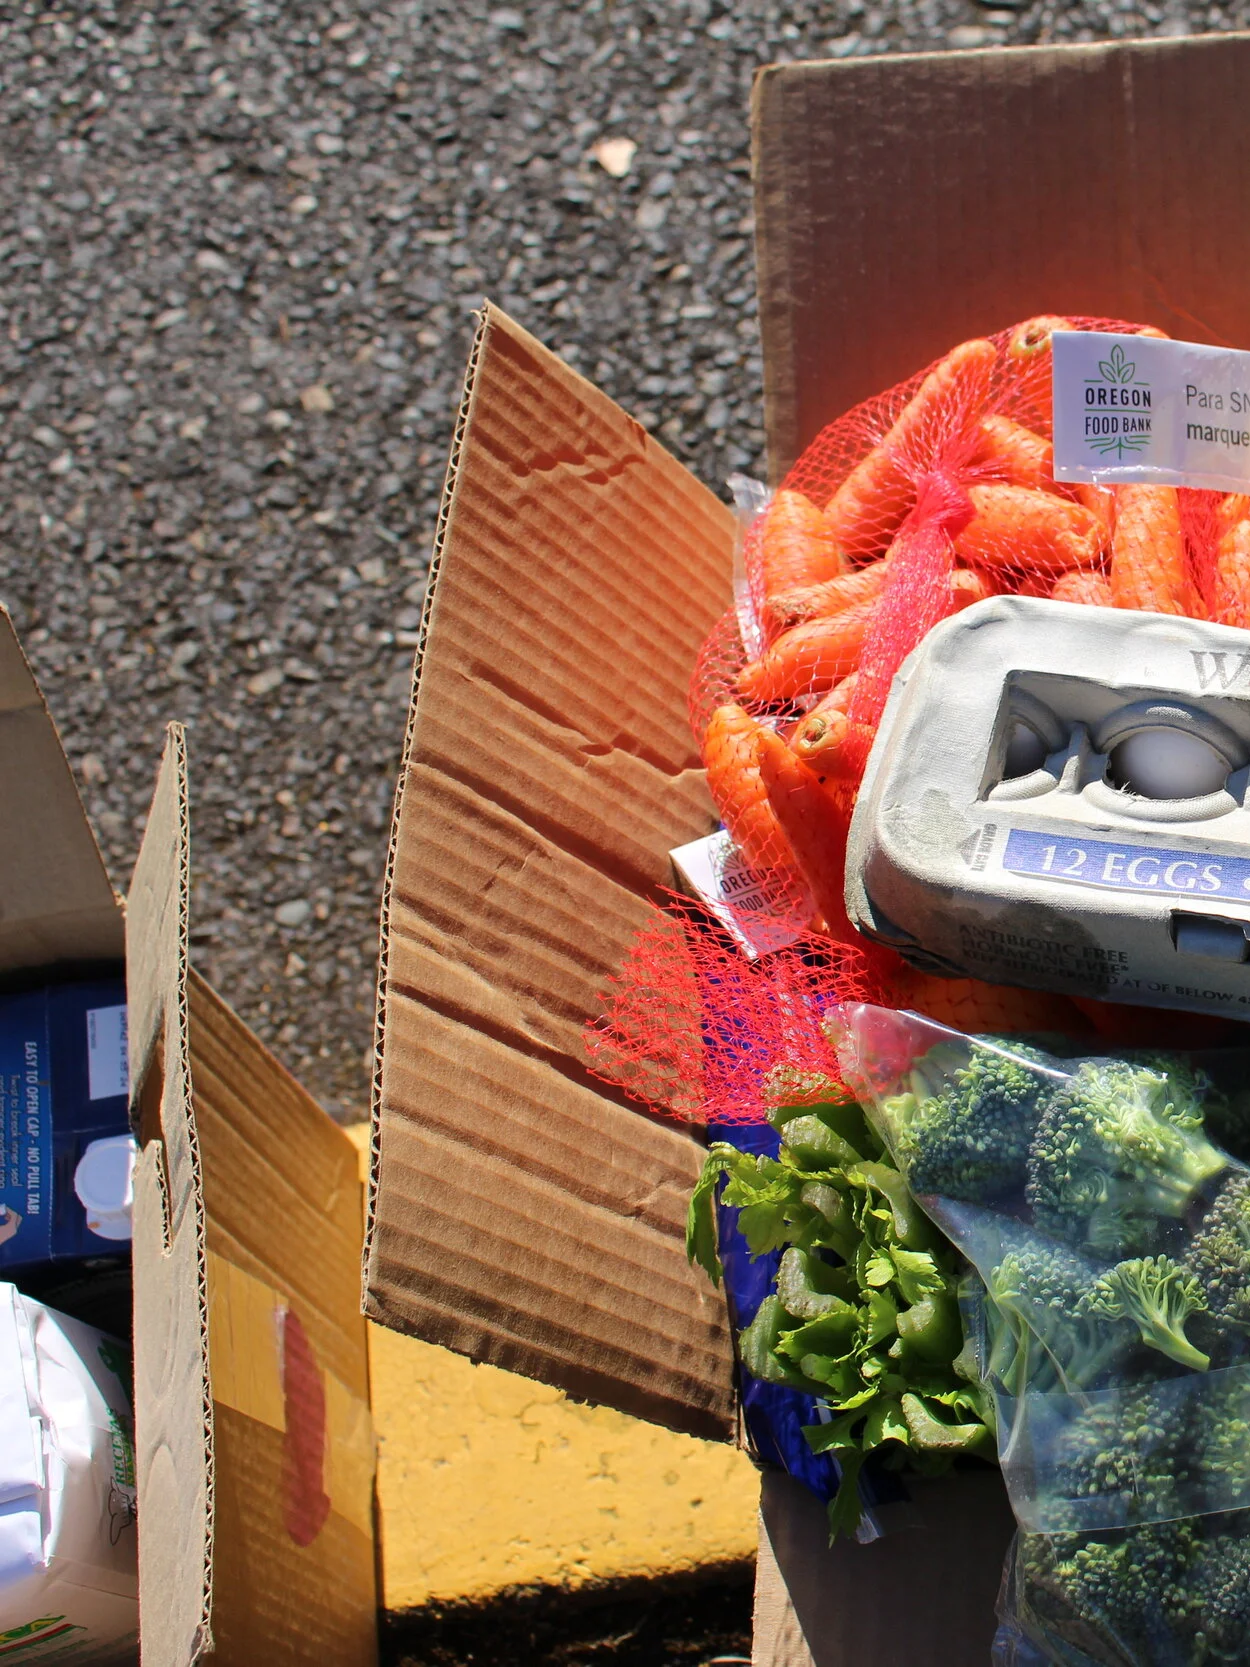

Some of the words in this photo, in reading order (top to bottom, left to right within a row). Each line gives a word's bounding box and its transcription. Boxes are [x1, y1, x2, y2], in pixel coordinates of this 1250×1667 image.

[1085, 387, 1151, 407] OREGON
[1185, 384, 1224, 411] Para
[1085, 416, 1119, 435] FOOD
[1122, 416, 1152, 433] BANK
[1186, 422, 1250, 450] marque
[1041, 845, 1087, 877] 12
[1101, 852, 1223, 892] EGGS
[959, 923, 1077, 957] ANTIBIOTIC
[1082, 946, 1129, 964] FREE
[1122, 977, 1143, 989] AT
[1175, 984, 1234, 1002] BELOW
[24, 1041, 38, 1067] EASY
[26, 1069, 39, 1084] TO
[26, 1086, 39, 1114] OPEN
[26, 1116, 39, 1137] CAP
[27, 1147, 40, 1163] NO
[12, 1167, 24, 1187] seal
[27, 1165, 40, 1190] PULL
[27, 1192, 40, 1215] TAB!
